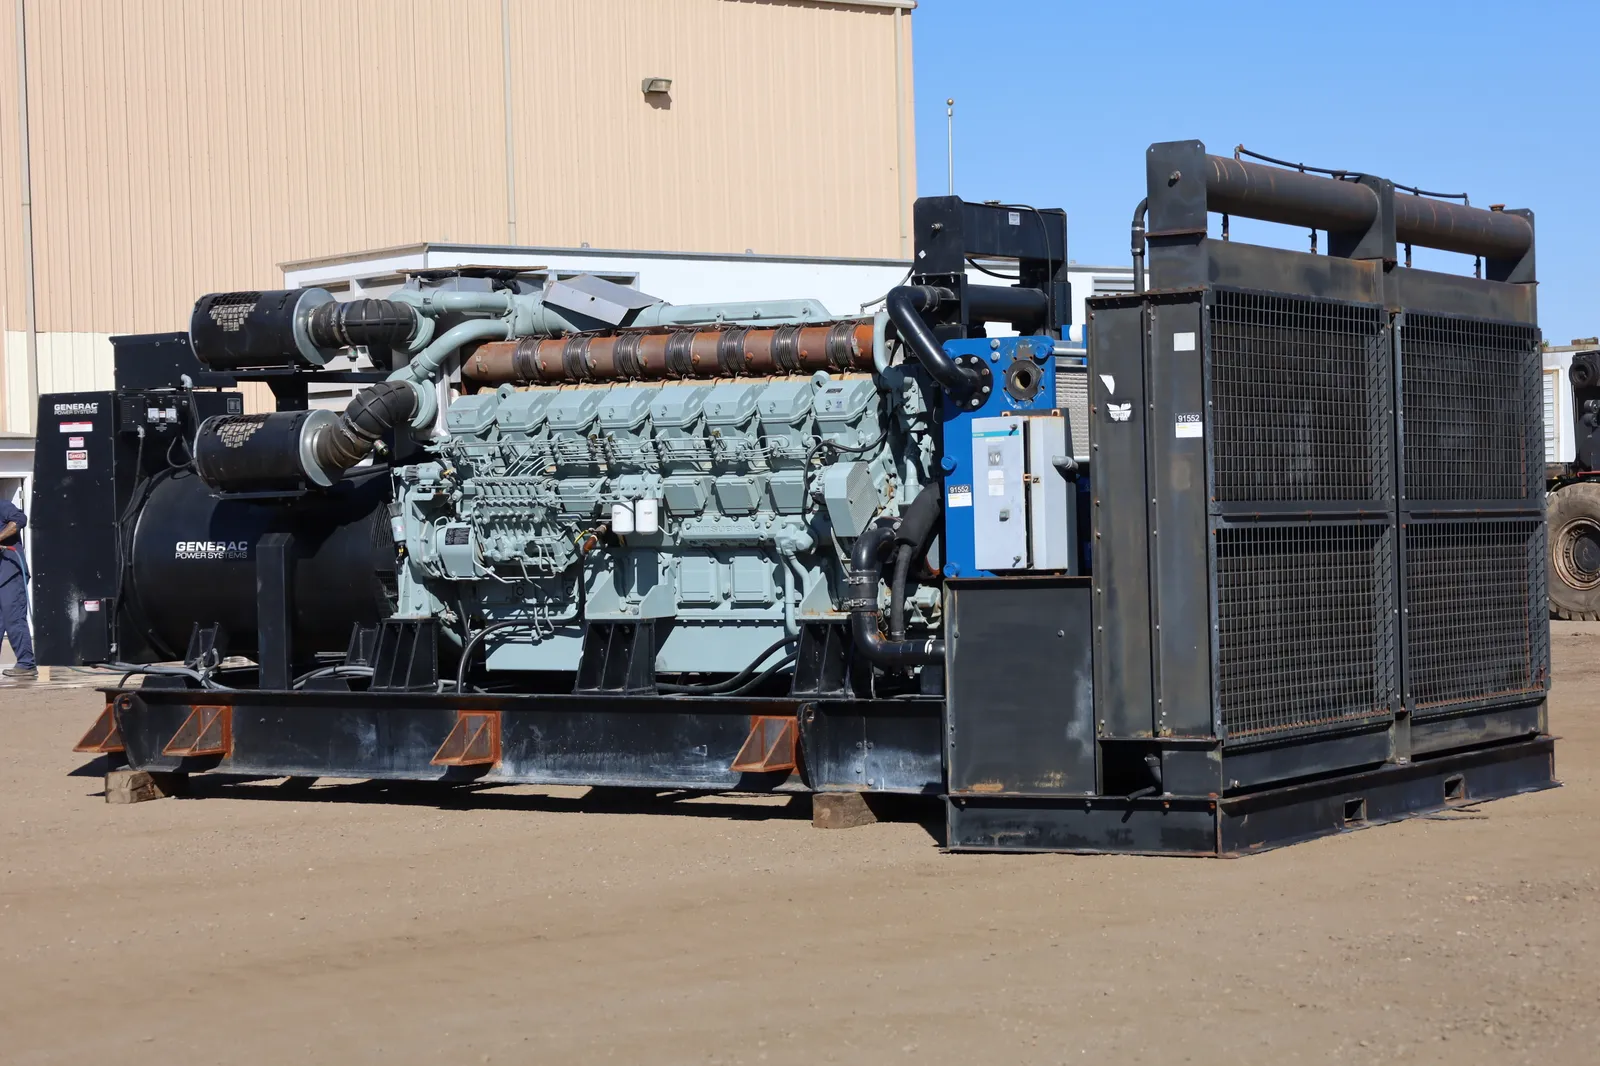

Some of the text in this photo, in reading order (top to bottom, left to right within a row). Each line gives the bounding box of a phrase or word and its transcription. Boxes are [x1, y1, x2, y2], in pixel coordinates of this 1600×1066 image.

[54, 403, 98, 411] GENERAC
[176, 541, 248, 552] GENERAC
[207, 551, 248, 559] SYSTEMS
